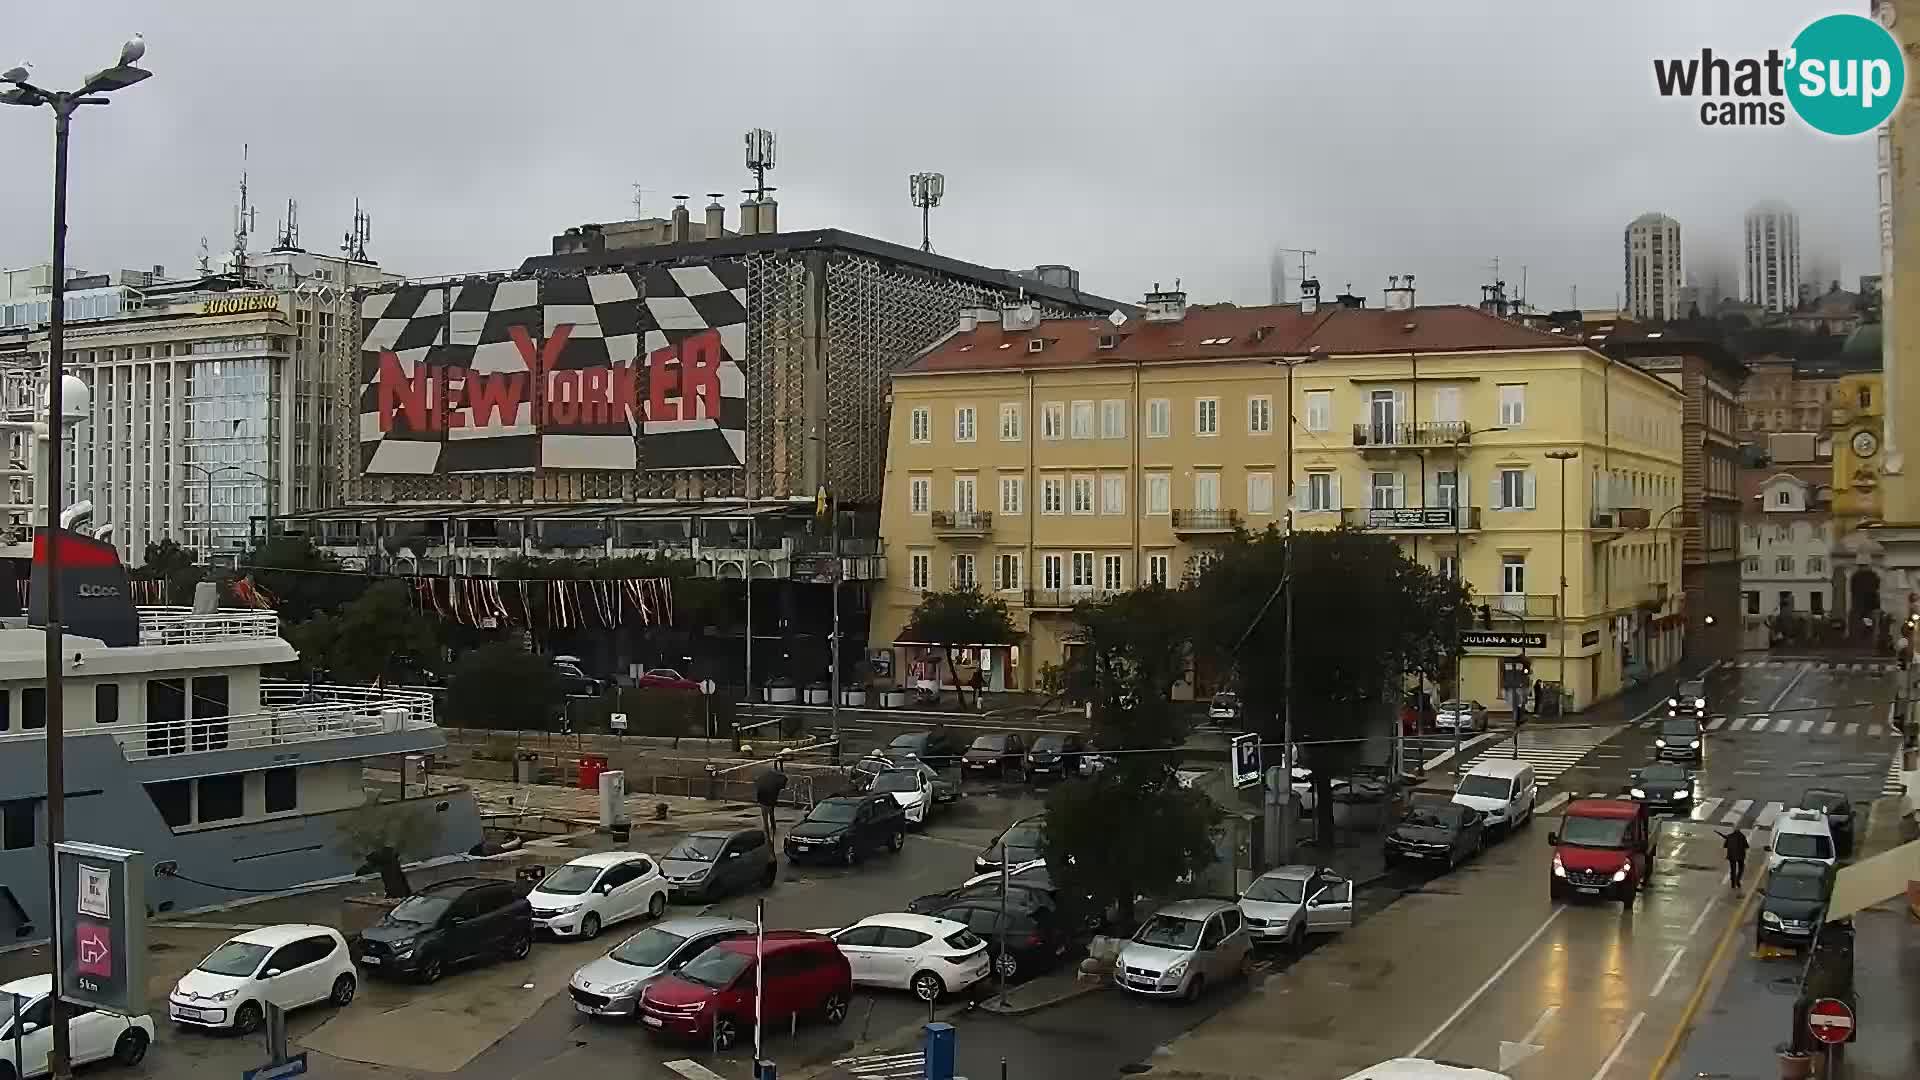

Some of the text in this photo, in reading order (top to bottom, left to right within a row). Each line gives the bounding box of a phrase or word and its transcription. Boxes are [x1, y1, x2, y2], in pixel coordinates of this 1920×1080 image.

[1463, 636, 1541, 645] JULIANA NAILS
[79, 978, 98, 992] 5 km
